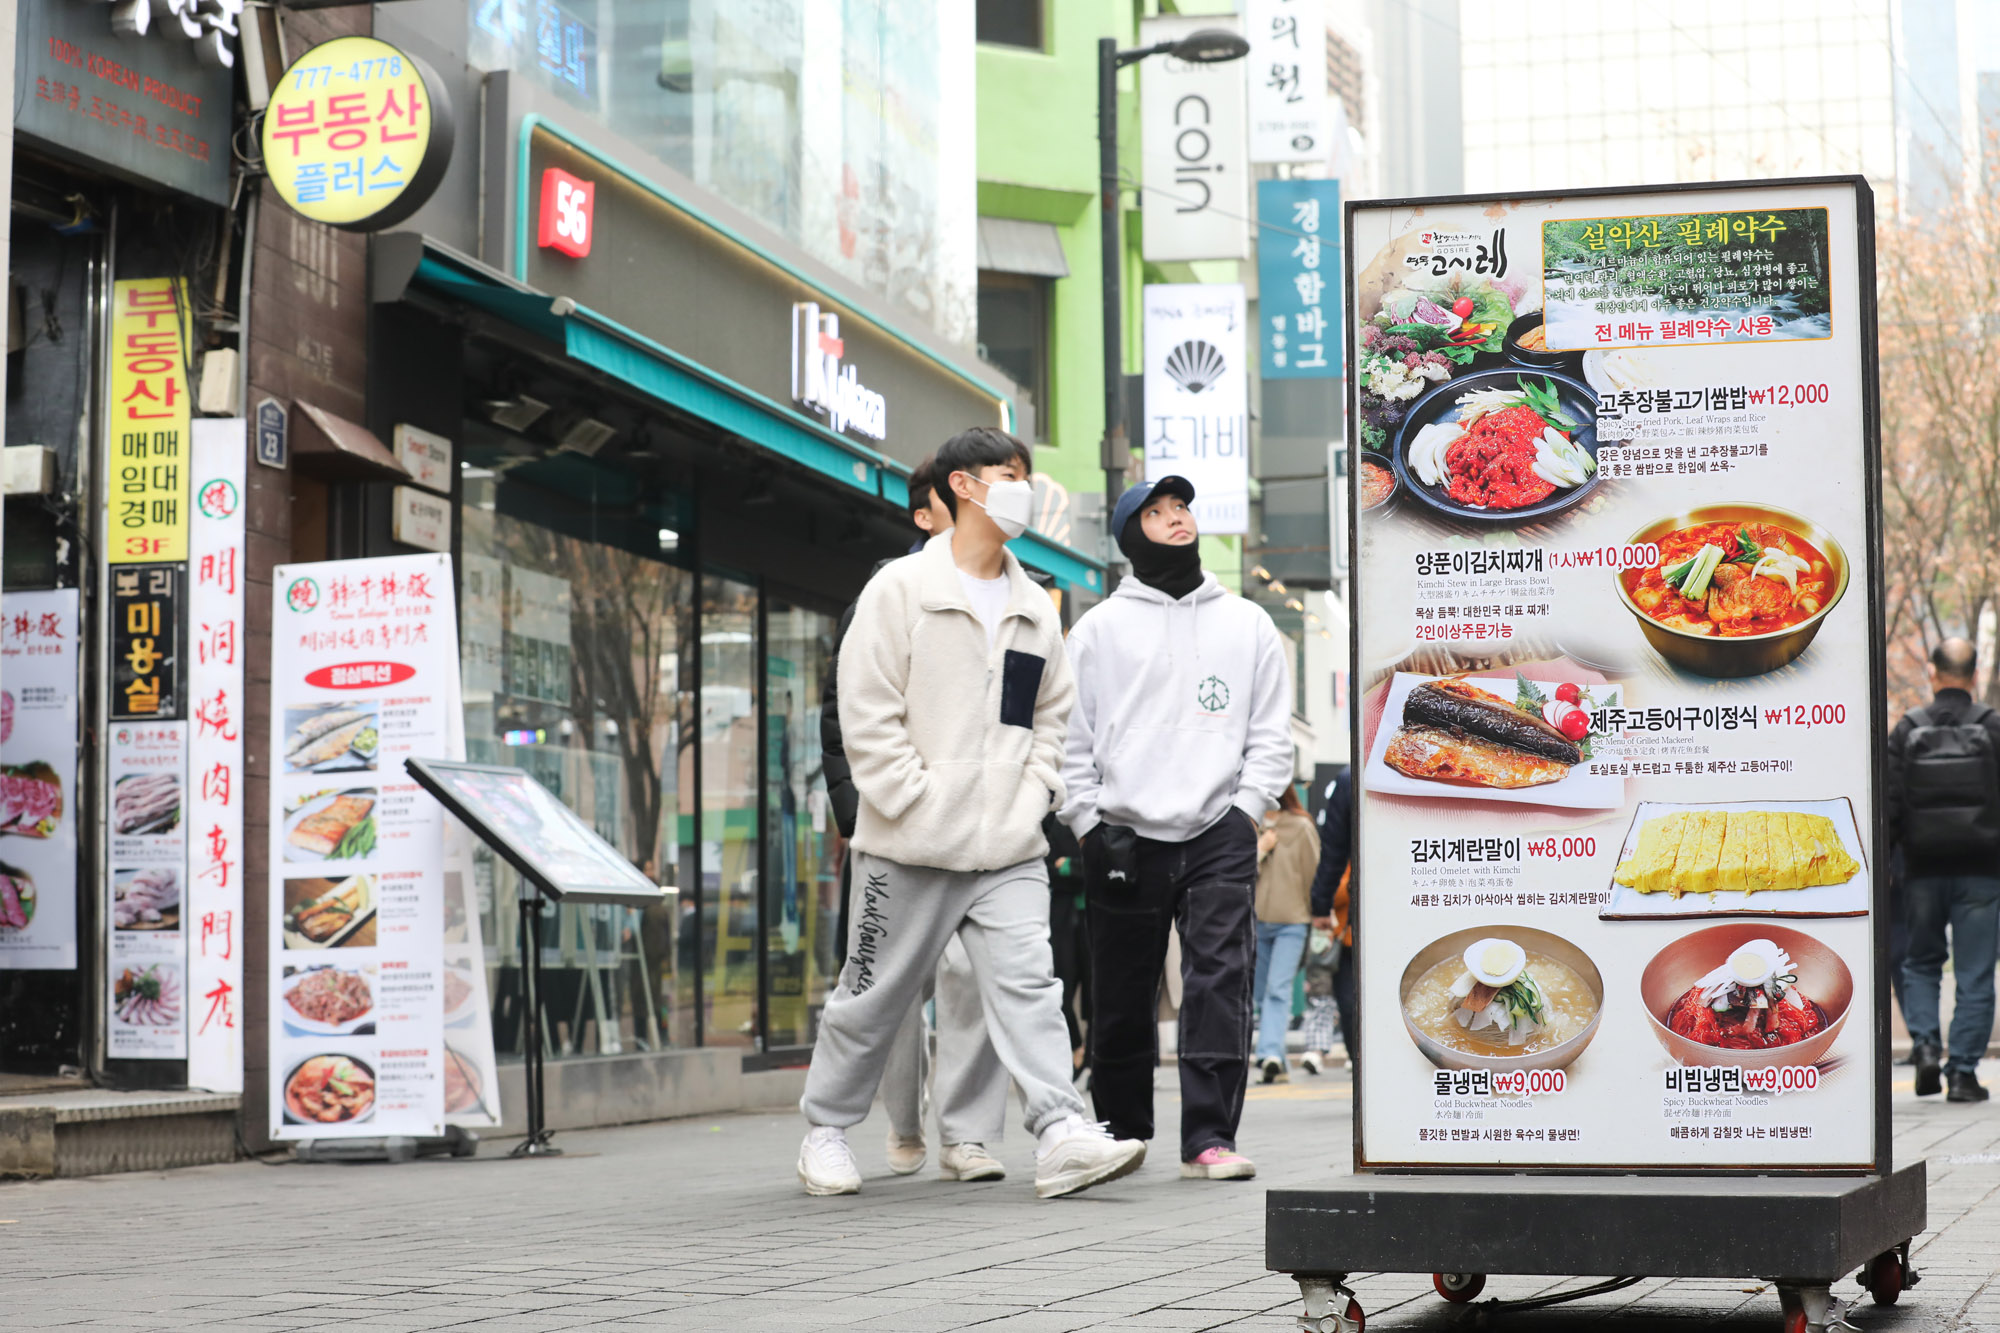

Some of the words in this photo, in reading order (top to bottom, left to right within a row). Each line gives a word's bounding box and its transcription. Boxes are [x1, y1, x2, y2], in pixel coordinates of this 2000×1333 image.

[48, 36, 83, 69] 100%
[87, 52, 139, 92] KOREAN
[144, 76, 202, 118] PRODUCT
[293, 56, 402, 90] 777-4778
[272, 84, 423, 157] 부동산
[1175, 95, 1224, 213] coin
[293, 156, 404, 203] 플러스
[556, 180, 587, 245] 5G
[1580, 220, 1662, 250] 설악산
[1652, 252, 1693, 266] 함유되어
[1697, 252, 1718, 263] 있는
[1291, 198, 1328, 369] 경성함바그
[1564, 272, 1596, 285] 면역력
[1713, 266, 1738, 278] 당뇨,
[1742, 263, 1783, 276] 심장병에
[1787, 263, 1808, 274] 좋고
[1555, 287, 1575, 300] 뇌에
[1580, 286, 1610, 300] 산소를
[1614, 285, 1655, 298] 전달하는
[1659, 283, 1688, 296] 기능이
[1692, 281, 1724, 294] 뛰어나
[1727, 280, 1759, 292] 피로가
[1762, 278, 1782, 291] 많이
[1786, 277, 1819, 290] 쌓이는
[1595, 299, 1648, 315] 직장인에게
[1651, 299, 1672, 312] 아주
[1675, 297, 1696, 311] 좋은
[1700, 294, 1777, 309] 건강약수입니다.
[1595, 323, 1612, 342] 전
[1619, 322, 1654, 340] 메뉴
[1737, 316, 1773, 336] 사용
[122, 286, 181, 419] 부동산
[1598, 386, 1747, 414] 고추장불고기쌈밥
[1748, 383, 1829, 408] ₩12,000
[1622, 417, 1661, 427] Stir-fried
[1664, 416, 1684, 426] Pork,
[1686, 416, 1703, 425] Leaf
[1706, 415, 1730, 424] Wraps
[1733, 414, 1746, 422] and
[1749, 413, 1766, 422] Rice
[122, 430, 178, 459] 매매
[1150, 415, 1244, 460] 조가비
[1600, 449, 1619, 462] 갖은
[1622, 448, 1661, 461] 양념으로
[1665, 447, 1683, 459] 맛을
[1687, 447, 1696, 458] 낸
[1700, 444, 1768, 458] 고추장불고기를
[121, 465, 177, 493] 임대
[1600, 465, 1609, 477] 맛
[1613, 464, 1632, 476] 좋은
[1636, 463, 1674, 475] 쌈밥으로
[1678, 461, 1706, 474] 한입에
[1710, 460, 1735, 472] 쏘옥~
[120, 498, 177, 528] 경매
[125, 536, 170, 555] 3F
[1416, 549, 1542, 575] 양푼이김치찌개
[116, 570, 172, 597] 보리
[1417, 580, 1444, 589] Kimchi
[1447, 579, 1467, 588] Stew
[1470, 579, 1477, 587] in
[1480, 578, 1502, 588] Large
[1505, 577, 1527, 586] Brass
[1530, 576, 1549, 585] Bowl
[1416, 607, 1434, 619] 목살
[1438, 606, 1460, 619] 듬뿍!
[1463, 605, 1501, 618] 대한민국
[1505, 604, 1523, 617] 대표
[1527, 603, 1549, 616] 찌개!
[1416, 622, 1513, 640] 2인이상주문가능
[125, 601, 163, 712] 미용실
[1590, 705, 1757, 733] 제주고등어구이정식
[1765, 704, 1846, 729] ₩12,000
[1592, 738, 1603, 746] Set
[1607, 738, 1626, 746] Menu
[1627, 737, 1634, 745] of
[1636, 736, 1659, 745] Grilled
[1661, 736, 1694, 744] Mackerel
[1590, 764, 1628, 776] 토실토실
[1632, 762, 1671, 775] 부드럽고
[1675, 762, 1703, 774] 두툼한
[1708, 761, 1736, 774] 제주산
[1740, 760, 1792, 773] 고등어구이!
[195, 548, 238, 1036] 明洞燒肉專門店
[1411, 838, 1520, 863] 김치계란말이
[1527, 837, 1596, 861] ₩8,000
[1411, 867, 1437, 875] Rolled
[1440, 867, 1470, 875] Omelet
[1474, 866, 1490, 874] with
[1493, 865, 1520, 874] Kimchi
[1411, 894, 1439, 906] 새콤한
[1443, 894, 1471, 906] 김치가
[1475, 893, 1513, 905] 아삭아삭
[1517, 893, 1545, 905] 씹히는
[1549, 892, 1610, 904] 김치계란말이!
[1434, 1072, 1488, 1095] 물냉면
[1496, 1072, 1564, 1096] ₩9,000
[1665, 1068, 1740, 1093] 비빔냉면
[1747, 1069, 1817, 1093] ₩9,000
[1434, 1100, 1452, 1108] Cold
[1455, 1100, 1498, 1108] Buckwheat
[1500, 1099, 1533, 1108] Noodles
[1663, 1098, 1685, 1107] Spicy
[1688, 1097, 1732, 1106] Buckwheat
[1735, 1097, 1768, 1106] Noodles
[1419, 1129, 1447, 1141] 쫄깃한
[1451, 1129, 1480, 1141] 면발과
[1483, 1129, 1512, 1141] 시원한
[1515, 1129, 1544, 1141] 육수의
[1547, 1129, 1580, 1141] 물냉면!
[1670, 1126, 1709, 1139] 매콤하게
[1713, 1126, 1742, 1139] 감칠맛
[1746, 1126, 1766, 1139] 나는
[1769, 1126, 1812, 1138] 비빔냉면!
